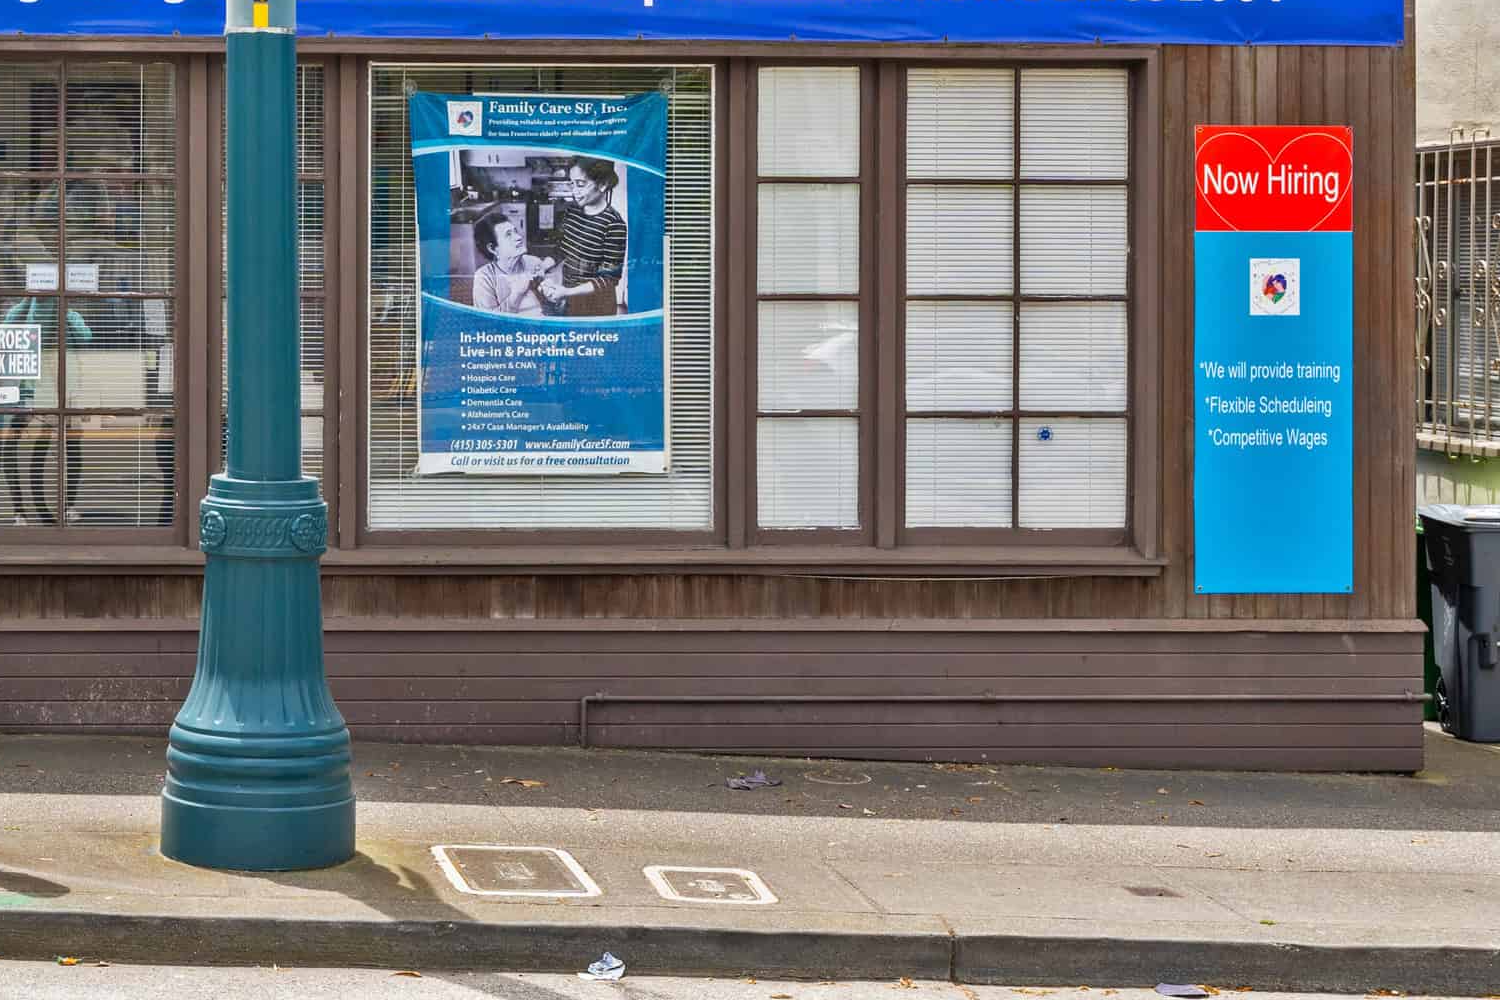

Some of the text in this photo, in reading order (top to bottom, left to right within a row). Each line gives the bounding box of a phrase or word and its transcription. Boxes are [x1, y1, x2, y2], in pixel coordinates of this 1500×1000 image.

[489, 101, 628, 116] Family Care SF, Inc.
[1203, 163, 1339, 203] Now Hiring
[460, 331, 619, 345] In-Home Support Services
[460, 345, 605, 357] Live-in & Part-time Care
[9, 353, 37, 374] HERE
[467, 361, 506, 371] Caregivers
[467, 373, 516, 383] Hospice Care
[1227, 361, 1247, 378] will
[1250, 361, 1294, 382] provide
[1297, 361, 1341, 383] training
[467, 385, 517, 394] Diabetic Care
[467, 398, 523, 407] Dementia Care
[511, 410, 530, 419] Care
[546, 422, 589, 432] Availability
[450, 439, 475, 451] (415)
[525, 438, 631, 452] www.FamilyCareSF.com
[1286, 428, 1328, 450] Wages
[450, 456, 470, 466] Call
[484, 456, 505, 466] visit
[520, 455, 536, 468] for
[537, 458, 544, 466] a
[545, 455, 565, 468] free
[567, 455, 630, 466] consultation
